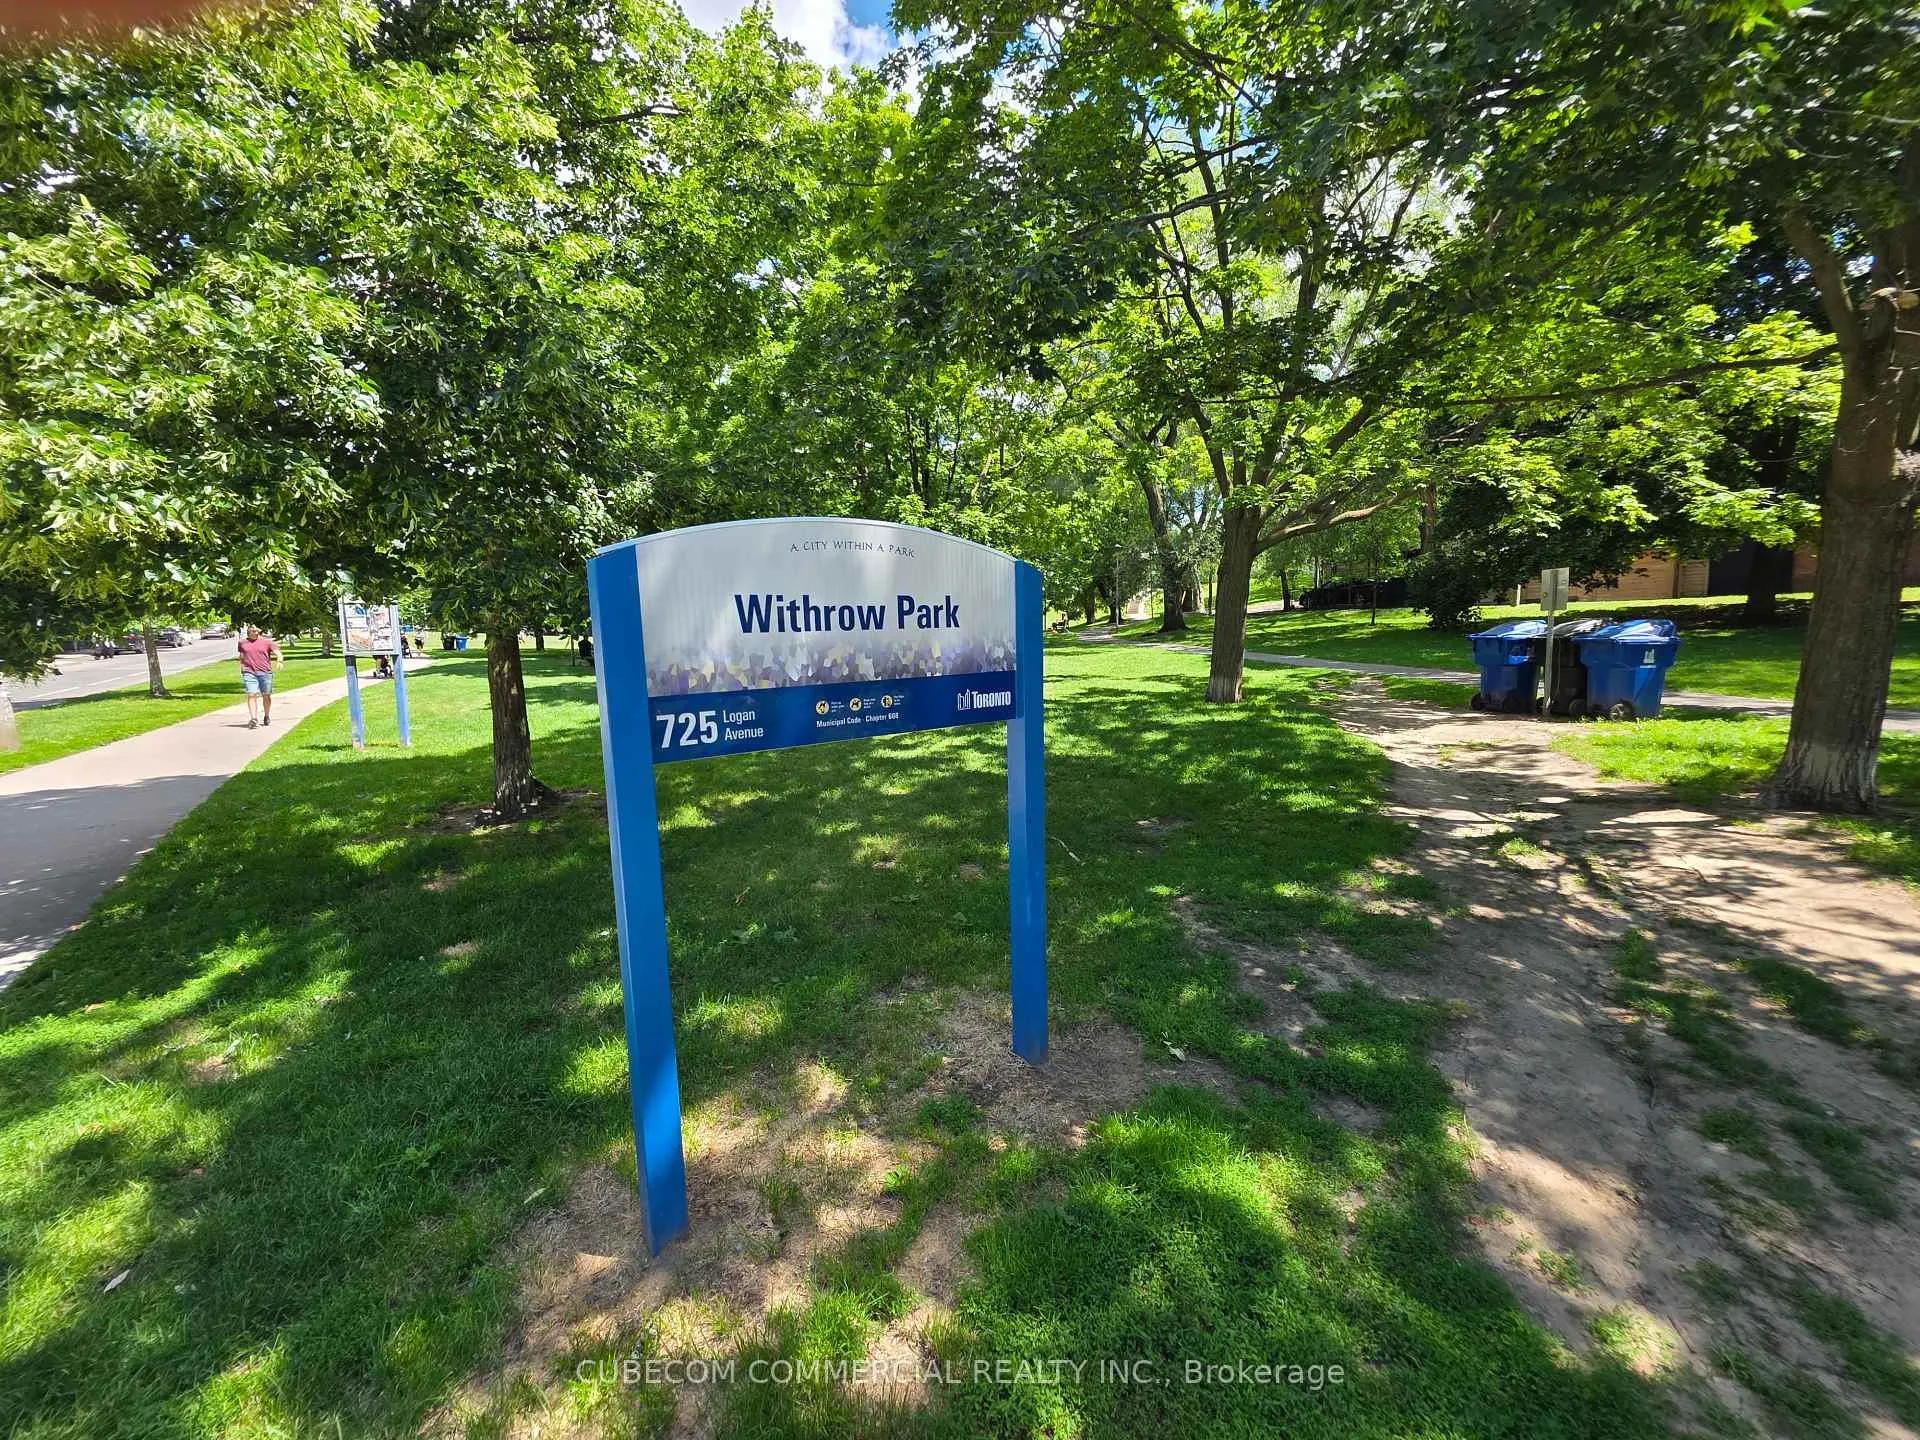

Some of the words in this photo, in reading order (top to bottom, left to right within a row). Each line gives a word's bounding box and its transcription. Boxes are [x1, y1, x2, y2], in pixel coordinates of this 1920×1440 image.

[790, 543, 799, 552] A
[803, 541, 828, 550] CITY
[833, 540, 873, 550] WITHIN
[877, 543, 885, 552] A
[889, 544, 915, 557] PARK
[734, 594, 886, 633] Withrow
[897, 595, 960, 630] Park
[971, 691, 1011, 709] TORONTO
[723, 710, 756, 724] Logan
[816, 718, 845, 727] Municipal
[866, 714, 887, 722] Chapter
[656, 710, 719, 749] 725
[724, 727, 764, 741] Avenue
